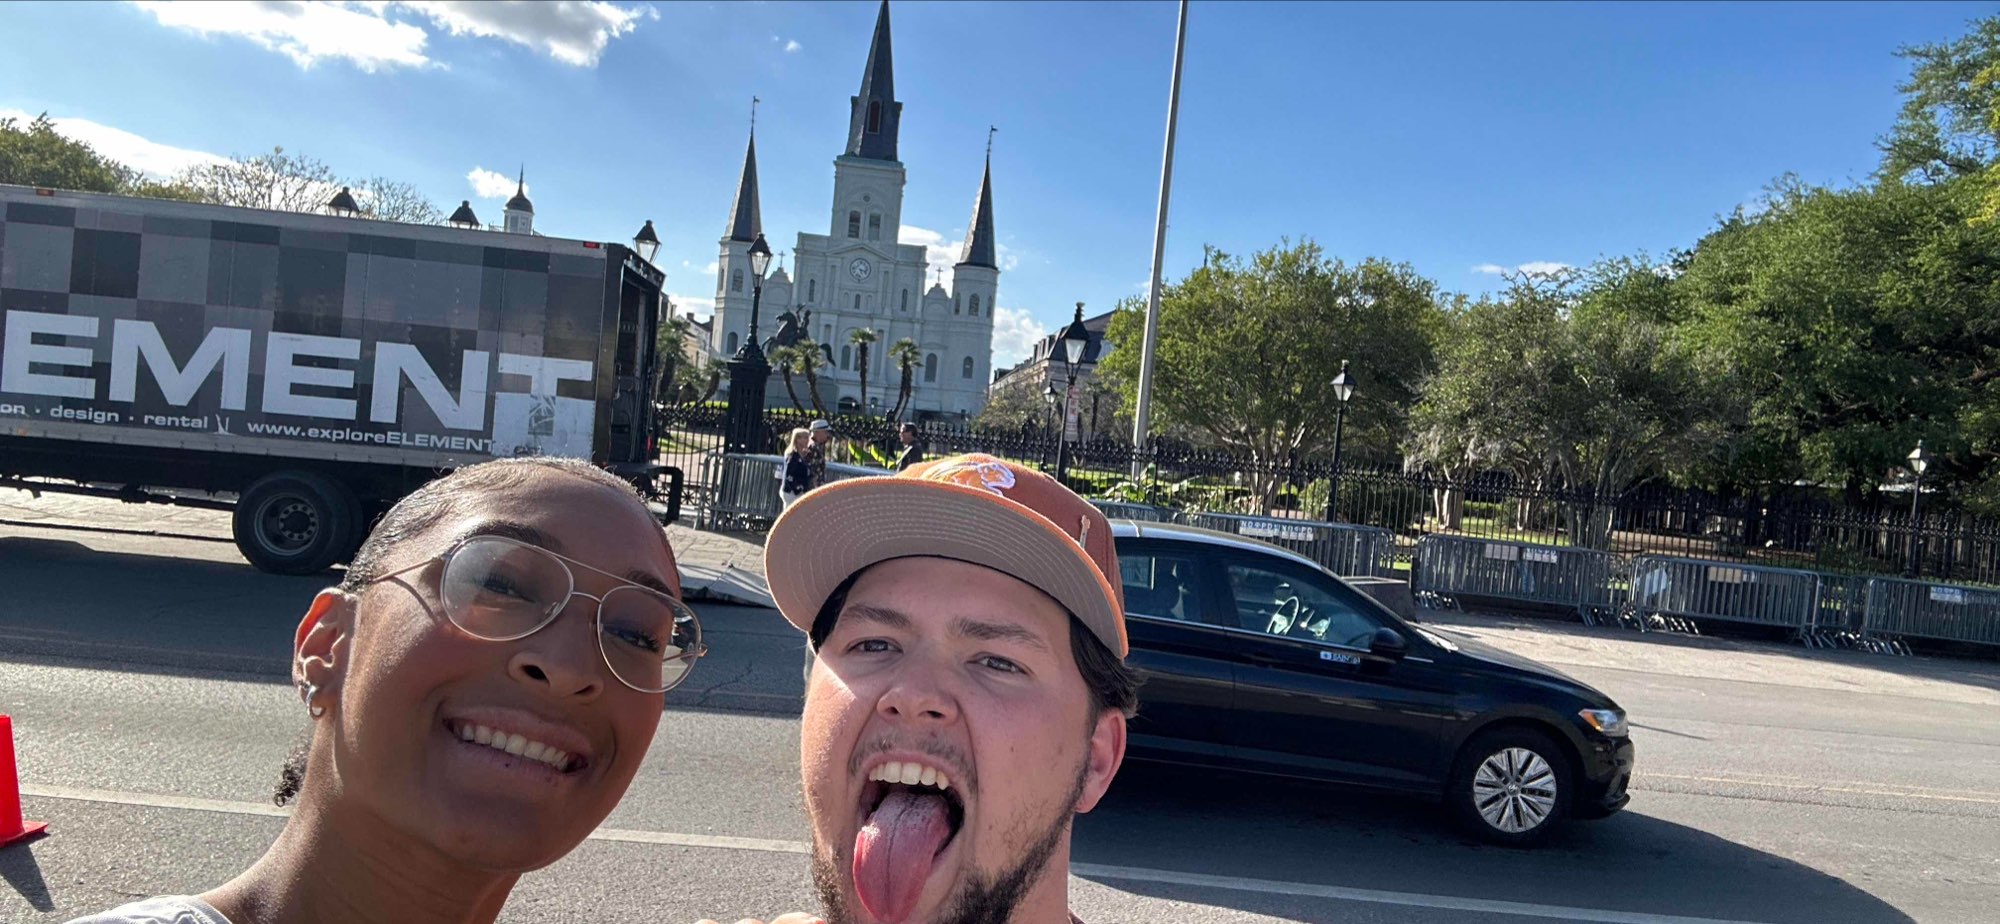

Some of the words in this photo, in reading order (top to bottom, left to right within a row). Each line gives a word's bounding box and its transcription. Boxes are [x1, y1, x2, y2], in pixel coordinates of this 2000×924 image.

[1, 309, 593, 436] EMENT
[49, 404, 120, 424] design
[143, 412, 208, 429] rental
